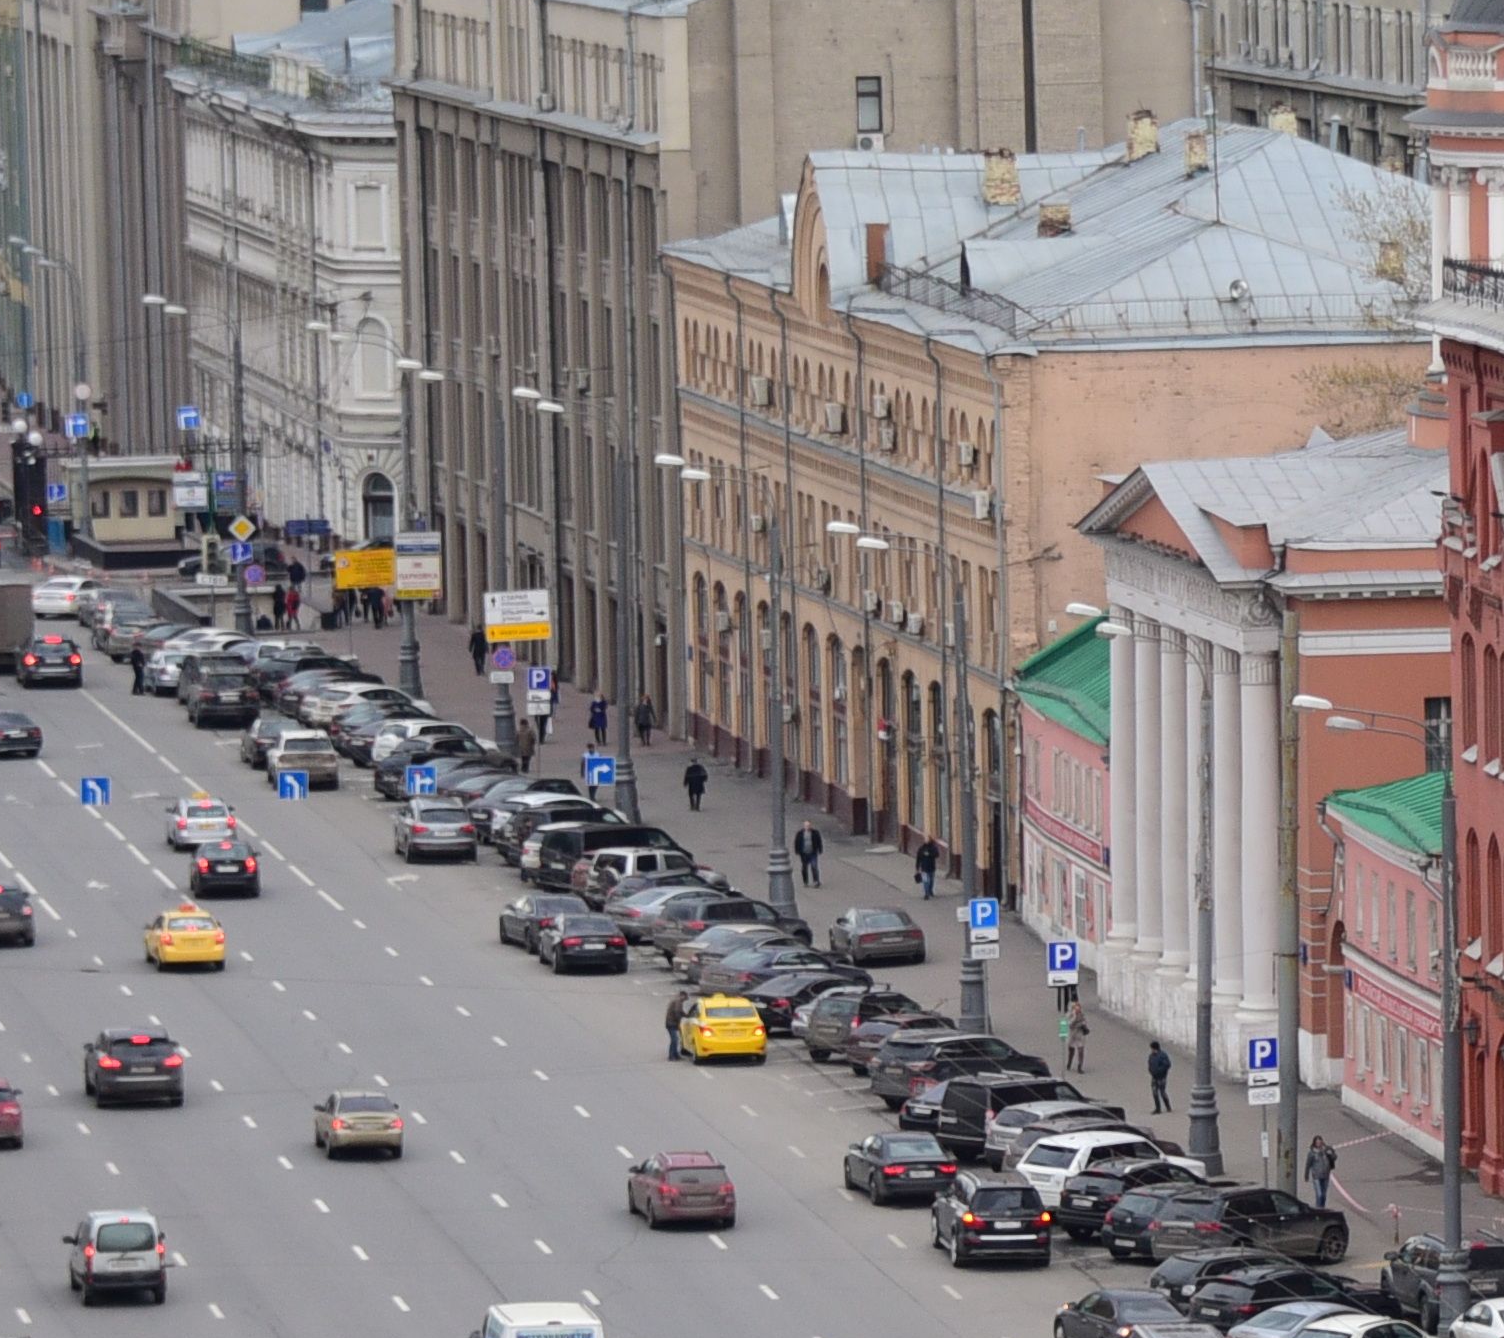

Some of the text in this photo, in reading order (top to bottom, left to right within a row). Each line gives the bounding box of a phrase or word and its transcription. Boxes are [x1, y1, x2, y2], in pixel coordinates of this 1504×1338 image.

[976, 902, 992, 926] P
[1055, 944, 1073, 969] P
[1255, 1040, 1272, 1068] P
